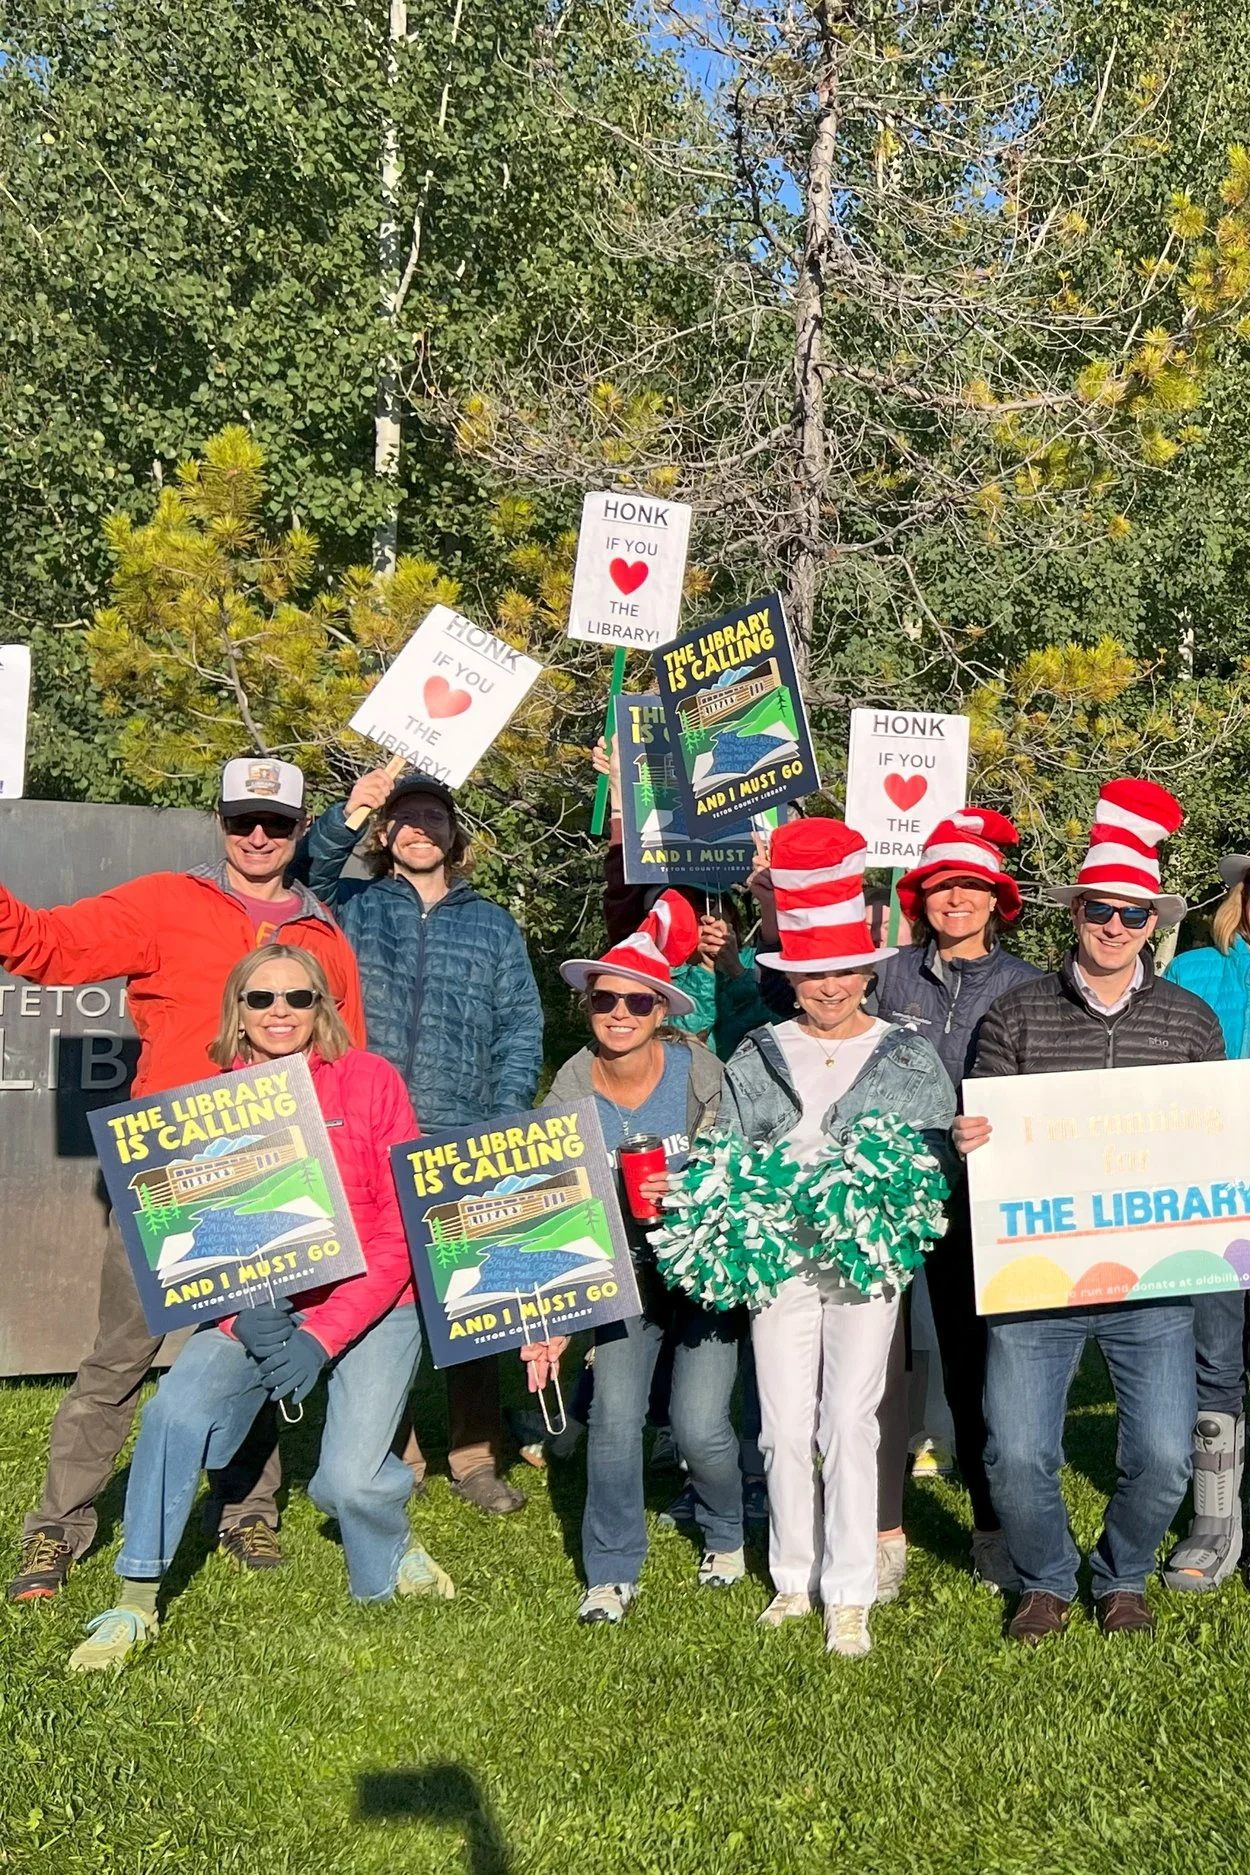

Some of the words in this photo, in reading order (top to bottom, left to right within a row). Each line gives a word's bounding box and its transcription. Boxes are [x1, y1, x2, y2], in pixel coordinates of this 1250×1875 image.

[603, 500, 669, 526] HONK
[606, 537, 621, 550] IF
[624, 539, 658, 556] YOU
[610, 601, 639, 617] THE
[445, 615, 523, 671] HONK
[587, 621, 660, 643] LIBRARY!
[663, 645, 696, 672] THE
[699, 608, 770, 653] LIBRARY
[432, 651, 451, 670] IF
[457, 661, 494, 694] YOU
[668, 668, 687, 693] IS
[693, 628, 775, 681] CALLING
[405, 715, 441, 746] THE
[632, 725, 651, 744] IS
[873, 715, 945, 736] HONK
[366, 724, 451, 785] LIBRARY!
[879, 753, 893, 765] IF
[900, 754, 936, 768] YOU
[696, 792, 725, 816] AND
[729, 787, 735, 801] I
[740, 774, 776, 797] MUST
[781, 760, 803, 779] GO
[887, 818, 920, 832] THE
[641, 850, 680, 863] AND
[687, 850, 692, 862] I
[700, 850, 745, 862] MUST
[107, 1106, 166, 1139] THE
[171, 1070, 289, 1124] LIBRARY
[1088, 1103, 1225, 1137] running
[115, 1135, 149, 1164] IS
[158, 1092, 297, 1149] CALLING
[407, 1146, 460, 1172] THE
[466, 1112, 578, 1159] LIBRARY
[414, 1170, 443, 1198] IS
[452, 1134, 585, 1186] CALLING
[1102, 1144, 1149, 1174] for
[1000, 1196, 1077, 1237] THE
[164, 1278, 214, 1307] AND
[220, 1272, 230, 1289] I
[239, 1251, 297, 1282] MUST
[308, 1240, 341, 1262] GO
[1081, 1288, 1102, 1297] run
[1107, 1283, 1131, 1295] and
[1132, 1281, 1175, 1293] donate
[1179, 1277, 1193, 1288] at
[449, 1312, 497, 1340] AND
[503, 1308, 512, 1326] I
[521, 1290, 577, 1319] MUST
[586, 1281, 618, 1301] GO
